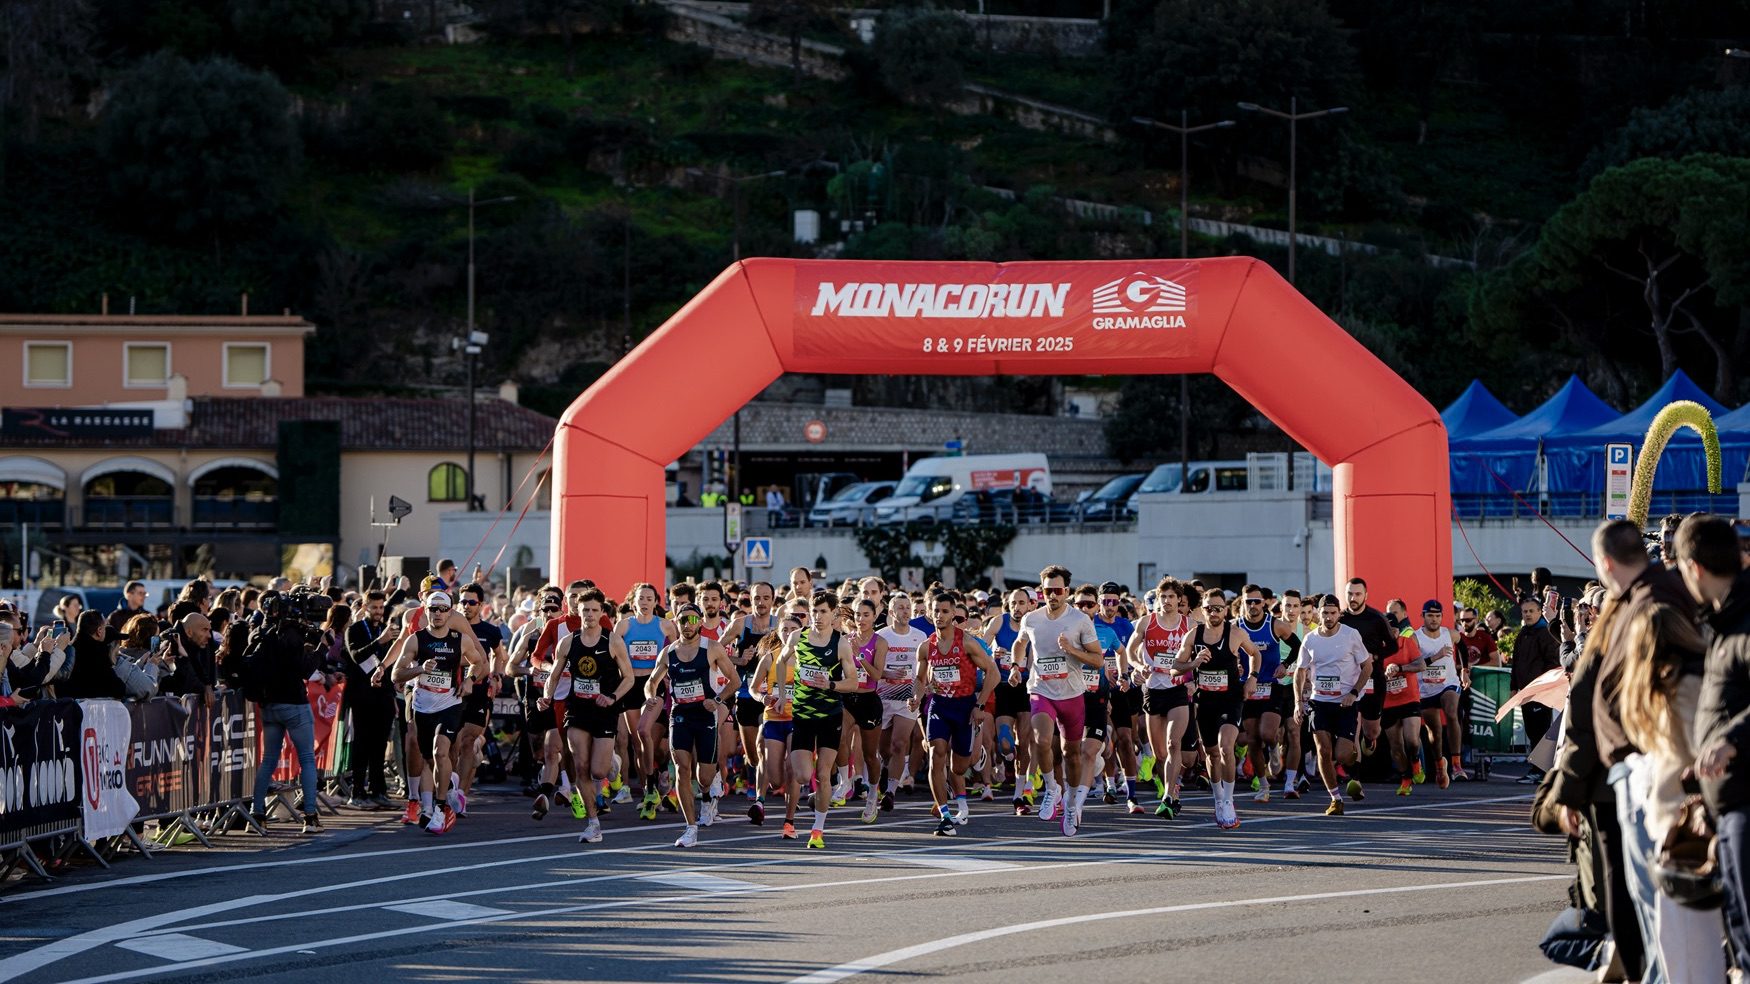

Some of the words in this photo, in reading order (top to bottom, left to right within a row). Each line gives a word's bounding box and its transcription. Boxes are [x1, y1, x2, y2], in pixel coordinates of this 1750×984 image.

[811, 282, 1072, 318] MONACORUN
[1092, 315, 1186, 330] GRAMAGLIA
[923, 337, 932, 353] 8
[936, 338, 948, 352] &
[954, 337, 963, 353] 9
[967, 335, 1032, 353] FÉVRIER
[1036, 337, 1074, 352] 2025
[51, 416, 68, 426] LA
[1615, 449, 1625, 462] P
[635, 645, 652, 653] 2043
[931, 656, 961, 667] MAROC
[1043, 662, 1060, 672] 2010
[680, 686, 695, 695] 2017
[133, 734, 195, 769] RUNNING
